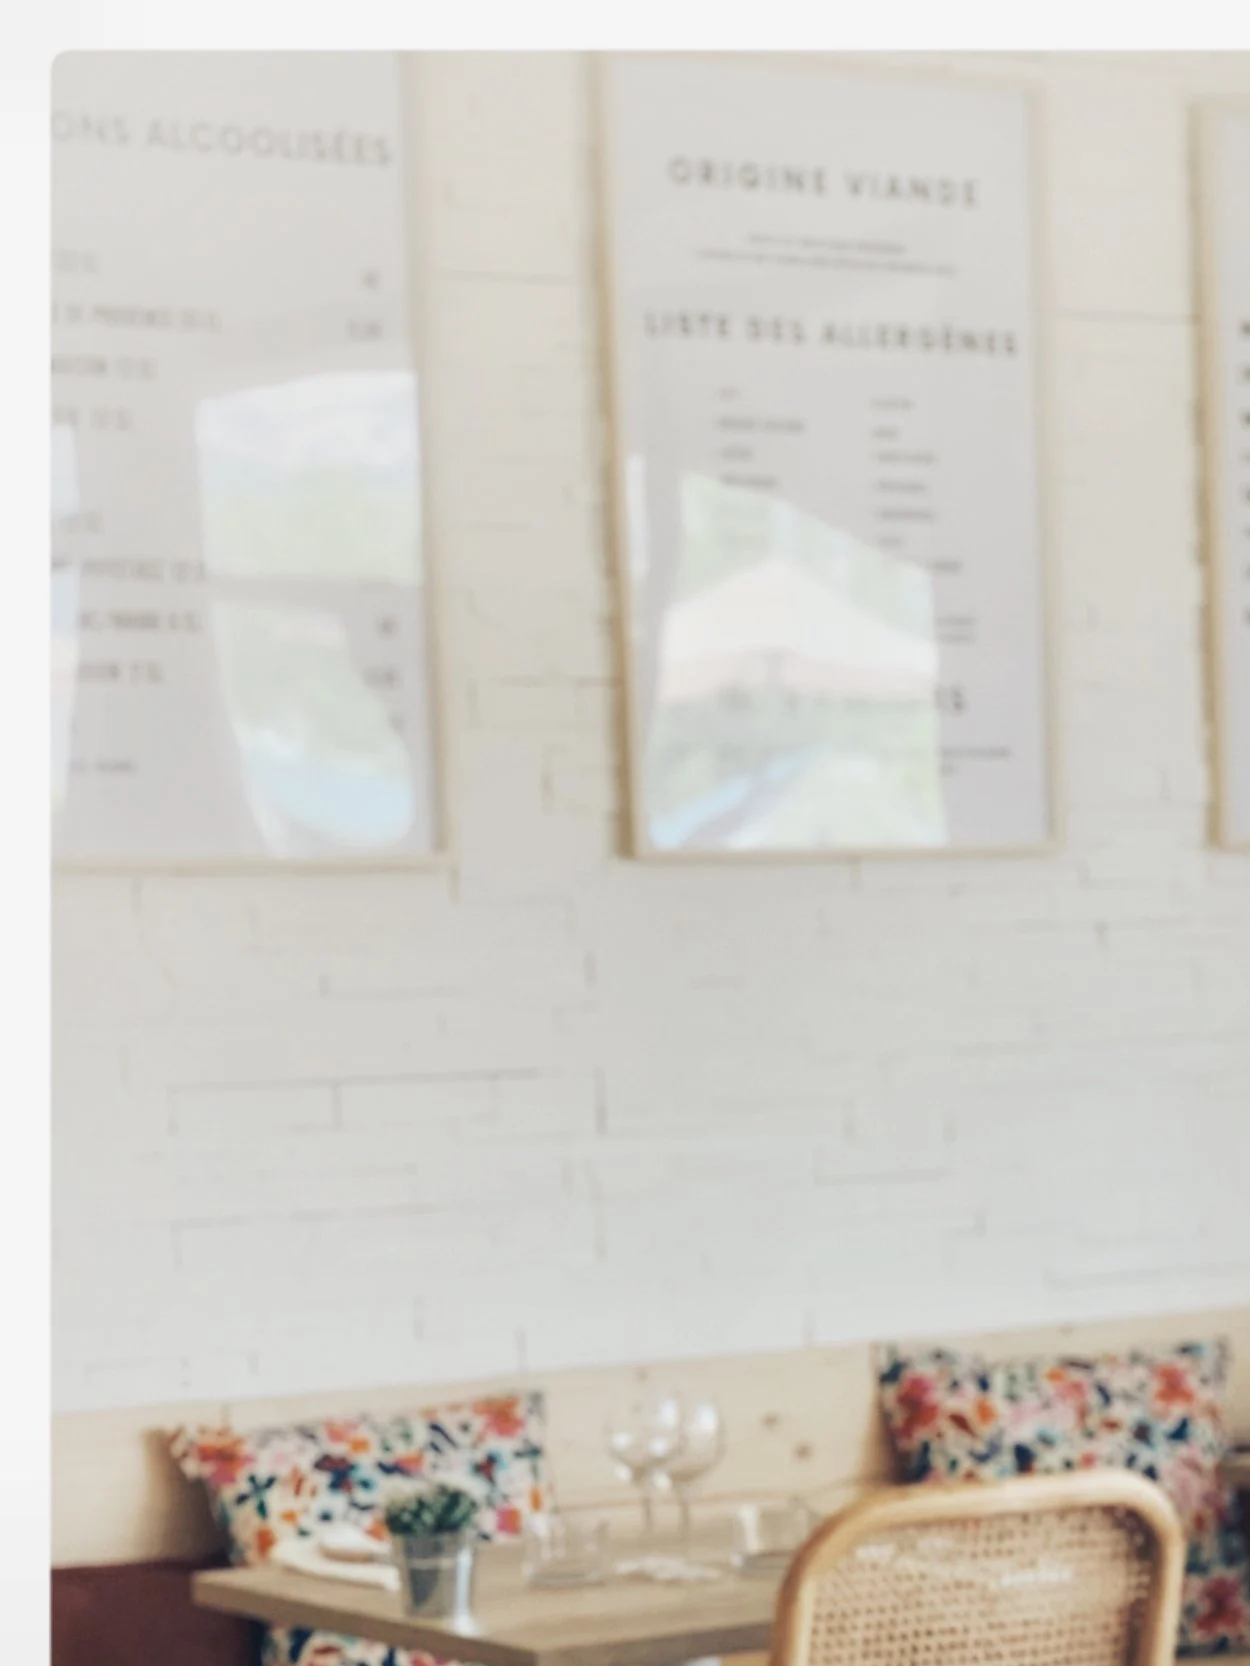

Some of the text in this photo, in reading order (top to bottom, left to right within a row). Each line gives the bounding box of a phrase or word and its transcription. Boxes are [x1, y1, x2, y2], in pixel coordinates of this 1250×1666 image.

[668, 155, 979, 208] ORIGINE VIANDE
[644, 309, 731, 340] LISTE
[747, 315, 806, 345] DES
